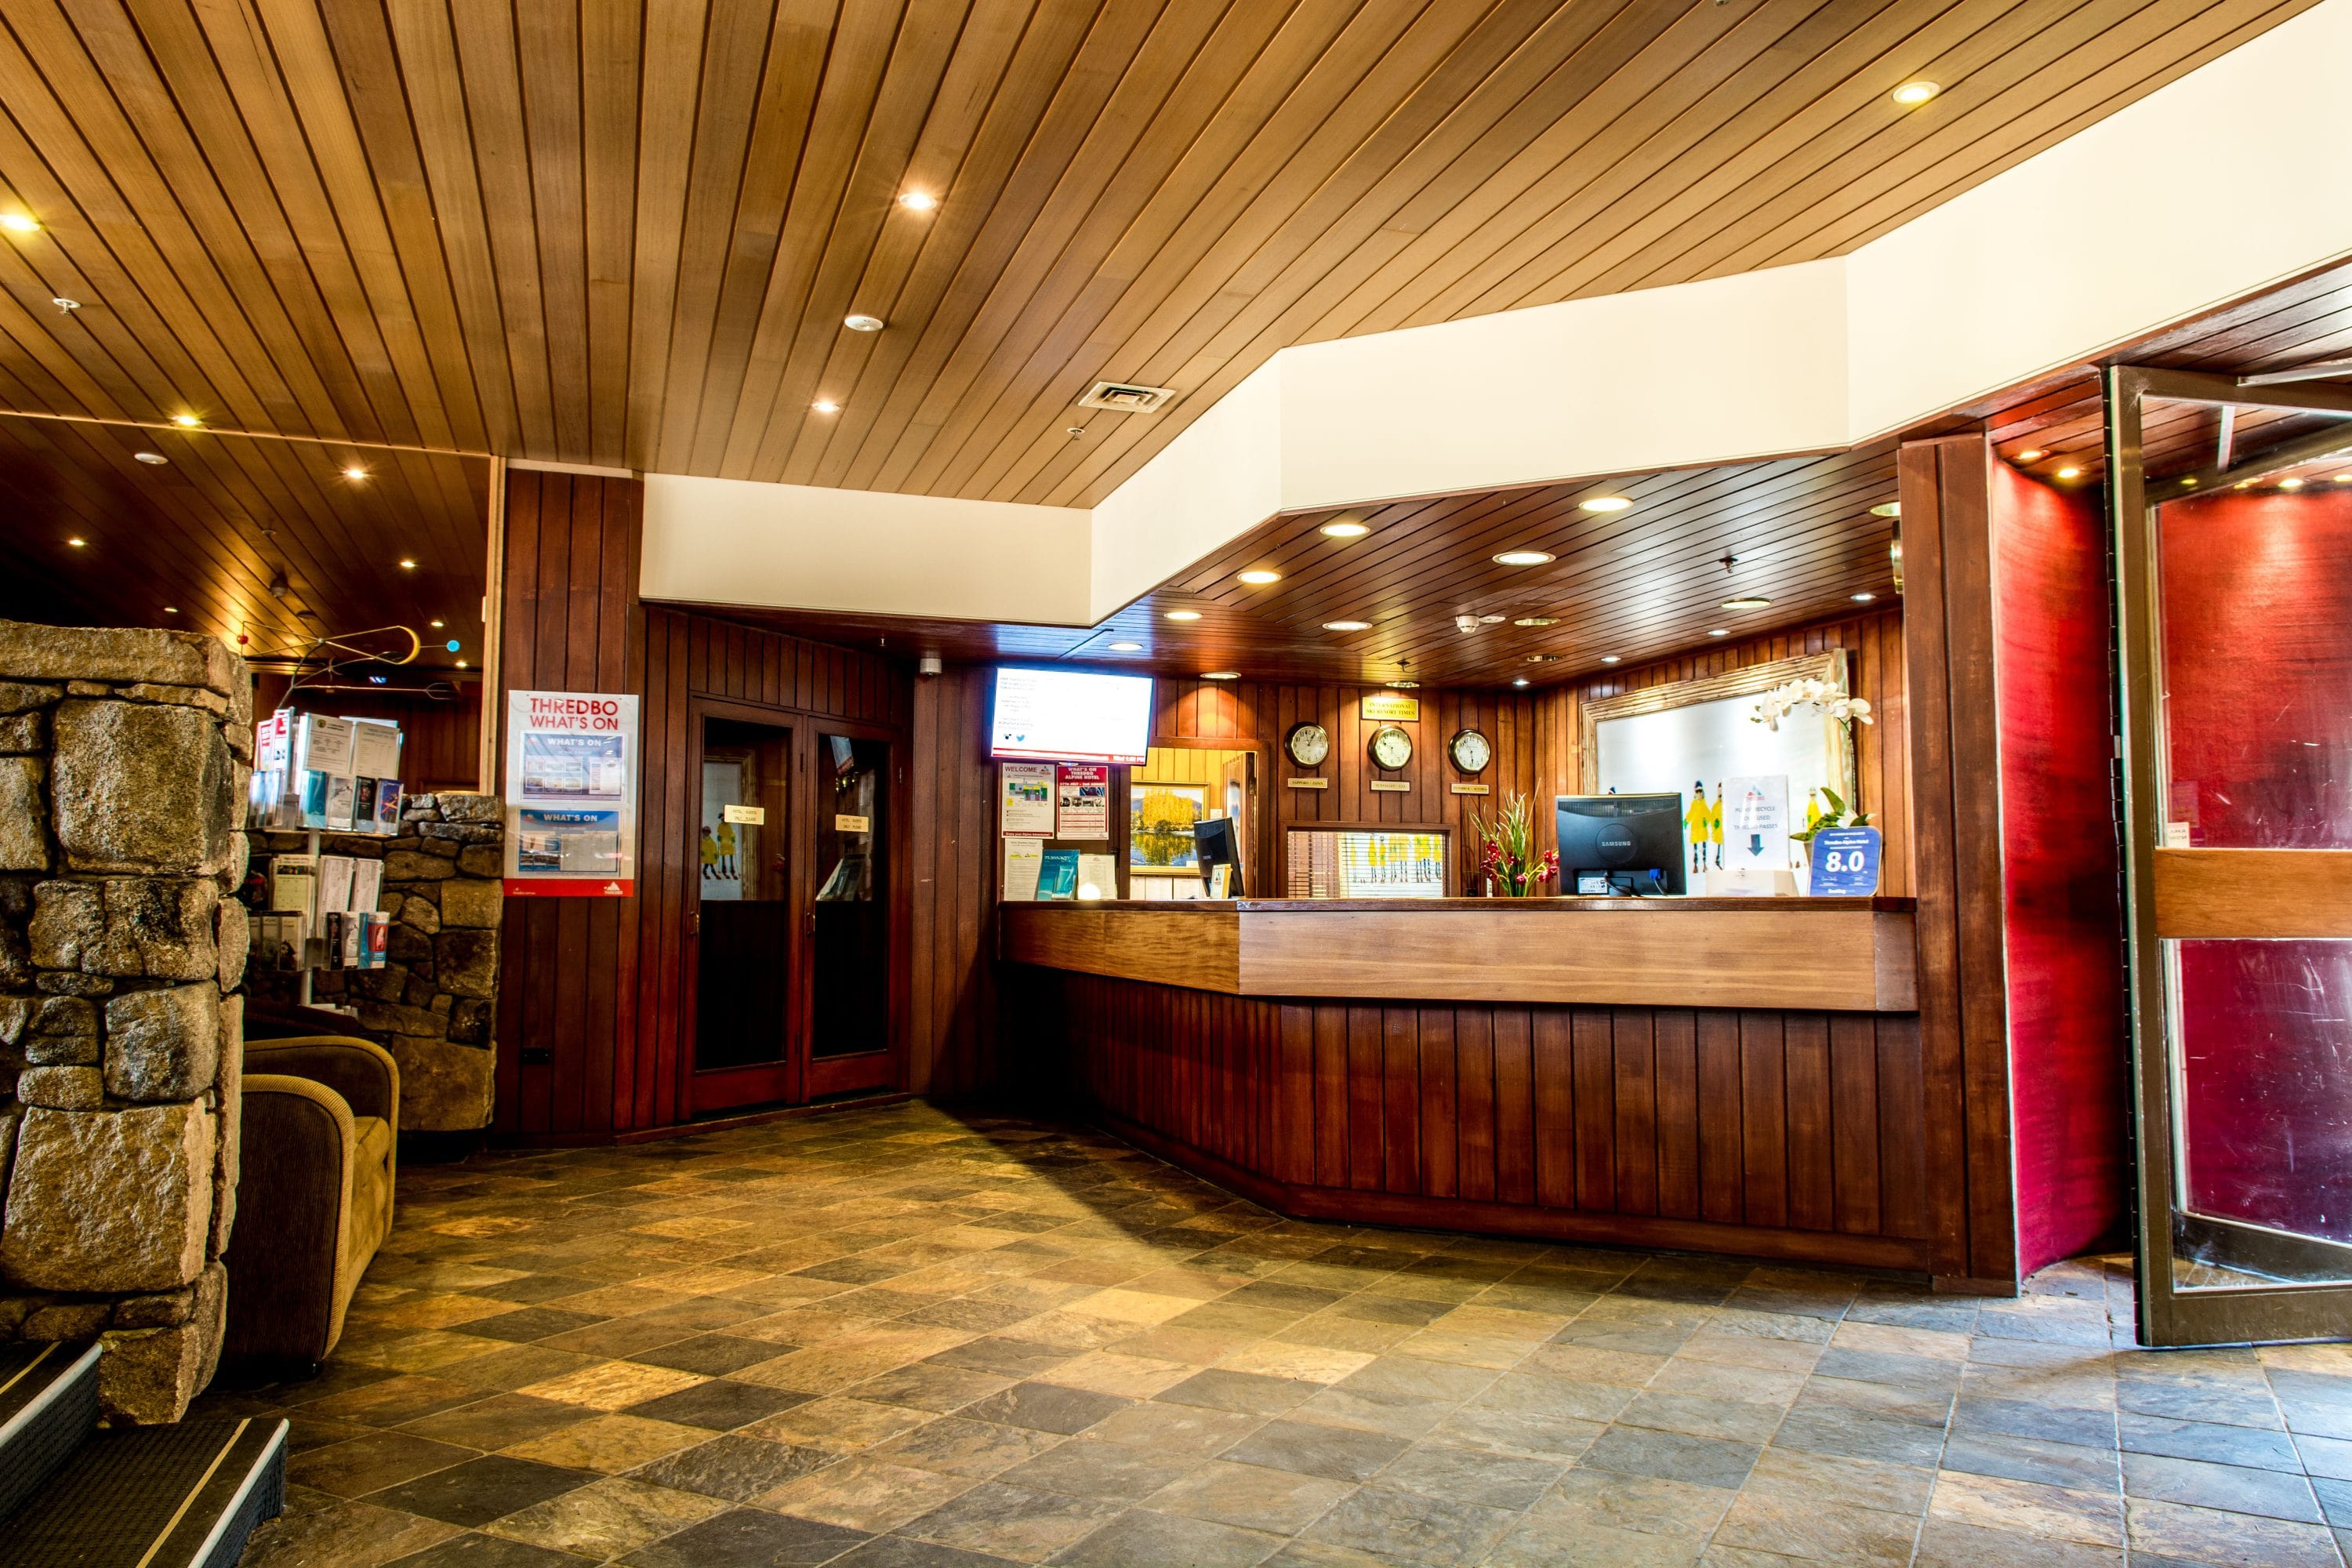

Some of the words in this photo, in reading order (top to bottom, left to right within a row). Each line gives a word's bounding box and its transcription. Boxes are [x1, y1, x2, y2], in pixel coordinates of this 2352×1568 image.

[530, 698, 619, 716] THREDBO
[530, 715, 588, 729] WHAT'S
[593, 717, 619, 730] ON
[1825, 851, 1865, 873] 8.0
